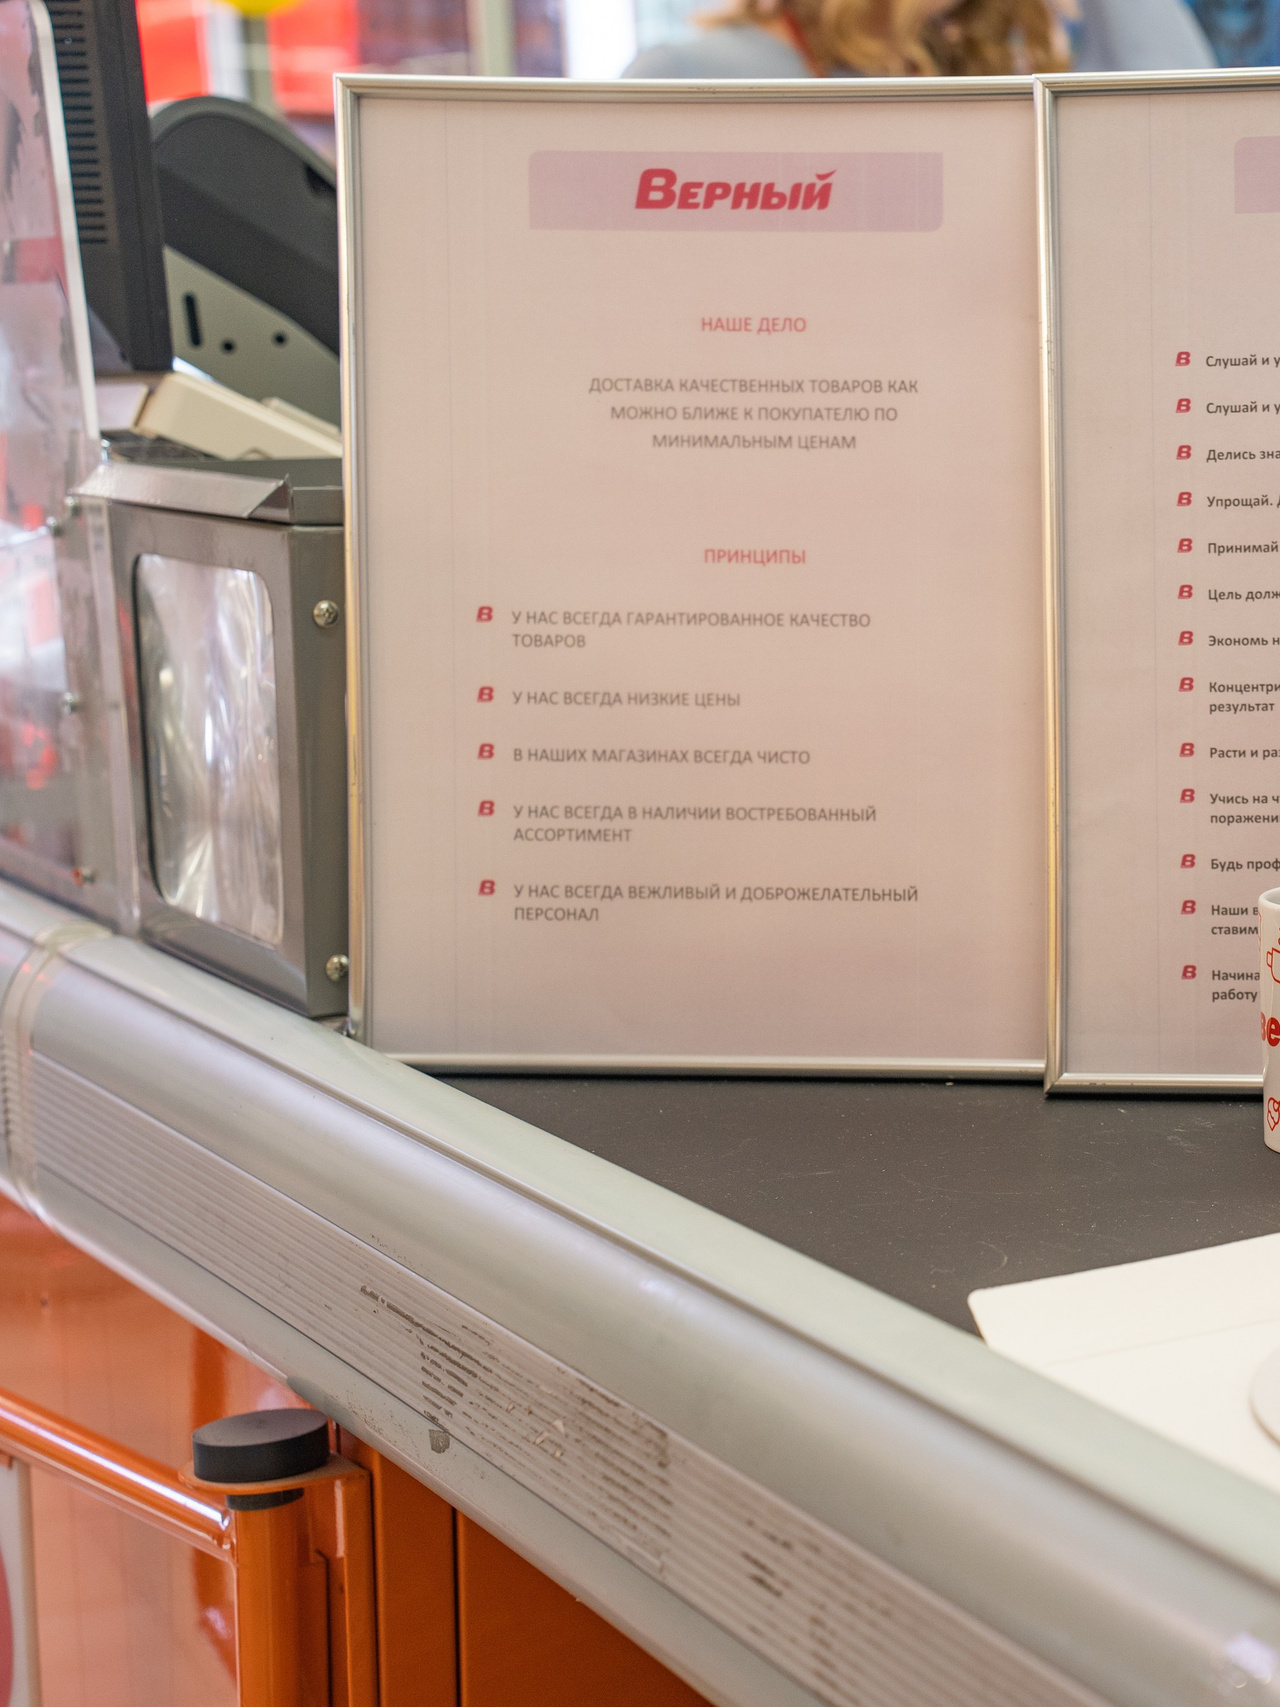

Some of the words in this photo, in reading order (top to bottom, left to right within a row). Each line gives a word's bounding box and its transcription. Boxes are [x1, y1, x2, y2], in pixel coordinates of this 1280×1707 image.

[701, 317, 752, 334] НАШЕ
[757, 317, 807, 335] ДЕЛО
[1205, 354, 1258, 369] Слушай
[1262, 355, 1269, 366] и
[589, 378, 674, 394] ДОСТАВКА
[679, 378, 804, 394] КАЧЕСТВЕННЫХ
[809, 379, 883, 394] ТОВАРОВ
[887, 379, 918, 394] КАК
[611, 406, 678, 421] МОЖНО
[682, 406, 739, 421] БЛИЖЕ
[744, 407, 753, 421] К
[758, 407, 870, 422] ПОКУПАТЕЛЮ
[874, 407, 898, 422] ПО
[1206, 401, 1258, 415] Слушай
[1262, 402, 1270, 413] и
[652, 434, 792, 449] МИНИМАЛЬНЫМ
[798, 435, 856, 452] ЦЕНАМ
[1206, 448, 1256, 463] Делись
[1207, 493, 1272, 510] Упрощай.
[1208, 541, 1279, 556] Принимай
[704, 549, 806, 567] ПРИНЦИПЫ
[1208, 589, 1242, 602] Цель
[512, 612, 522, 626] У
[527, 611, 559, 626] НАС
[563, 611, 622, 629] ВСЕГДА
[627, 612, 785, 628] ГАРАНТИРОВАННОЕ
[790, 613, 870, 628] КАЧЕСТВО
[512, 634, 586, 649] ТОВАРОВ
[1209, 635, 1268, 648] Экономь
[513, 692, 522, 706] У
[527, 692, 560, 706] НАС
[564, 692, 623, 708] ВСЕГДА
[627, 692, 690, 707] НИЗКИЕ
[695, 692, 741, 709] ЦЕНЫ
[1209, 701, 1274, 715] результат
[513, 748, 523, 763] В
[527, 748, 588, 763] НАШИХ
[592, 749, 689, 764] МАГАЗИНАХ
[694, 749, 752, 766] ВСЕГДА
[757, 750, 811, 765] ЧИСТО
[1210, 748, 1246, 760] Расти
[1250, 749, 1259, 758] и
[1210, 793, 1248, 806] Учись
[1253, 794, 1268, 804] на
[513, 806, 523, 820] У
[528, 806, 560, 820] НАС
[564, 806, 623, 822] ВСЕГДА
[628, 806, 637, 821] В
[642, 806, 721, 822] НАЛИЧИИ
[726, 804, 876, 822] ВОСТРЕБОВАННЫЙ
[513, 827, 632, 842] АССОРТИМЕНТ
[1211, 858, 1243, 871] Будь
[514, 885, 524, 900] У
[528, 885, 560, 900] НАС
[565, 885, 623, 902] ВСЕГДА
[628, 883, 720, 901] ВЕЖЛИВЫЙ
[725, 887, 737, 901] И
[741, 884, 918, 904] ДОБРОЖЕЛАТЕЛЬНЫЙ
[514, 907, 599, 922] ПЕРСОНАЛ
[1211, 905, 1248, 916] Наши
[1212, 970, 1260, 981] Начина
[1212, 988, 1258, 1003] работу
